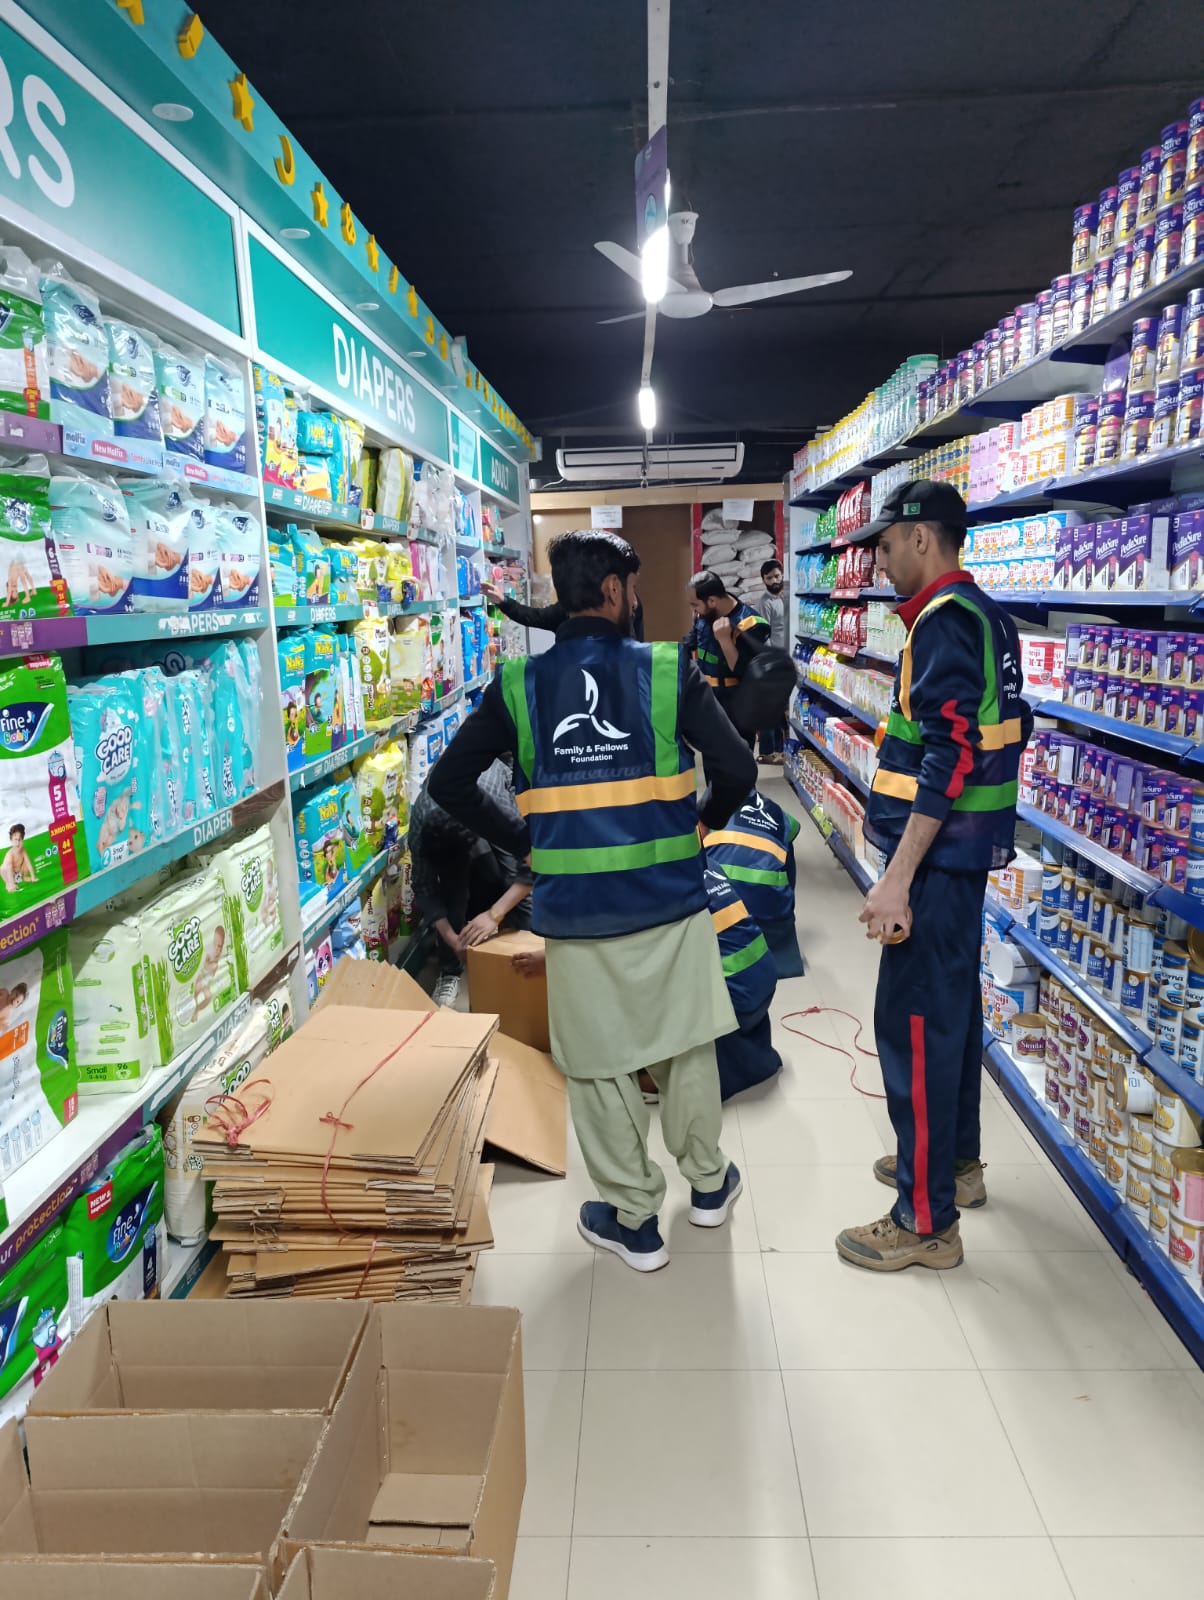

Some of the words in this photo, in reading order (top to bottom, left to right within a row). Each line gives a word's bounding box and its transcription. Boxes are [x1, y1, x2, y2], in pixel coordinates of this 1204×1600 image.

[332, 322, 417, 435] DIAPERS
[491, 456, 510, 491] ADULT
[1121, 534, 1147, 558] PediaSure
[1, 708, 25, 732] fine
[4, 728, 30, 744] Baby
[96, 726, 132, 760] GOOD
[102, 746, 132, 775] CARE
[554, 745, 584, 756] Family
[586, 745, 592, 753] &
[595, 743, 629, 752] Fellows
[571, 754, 613, 763] Foundation
[53, 785, 61, 801] 5
[193, 809, 233, 847] DIAPER
[168, 916, 201, 961] GOOD
[174, 932, 201, 973] CARE
[86, 1066, 108, 1075] Small
[117, 1063, 128, 1071] 96
[90, 1193, 106, 1208] NEW
[15, 1186, 74, 1253] protection
